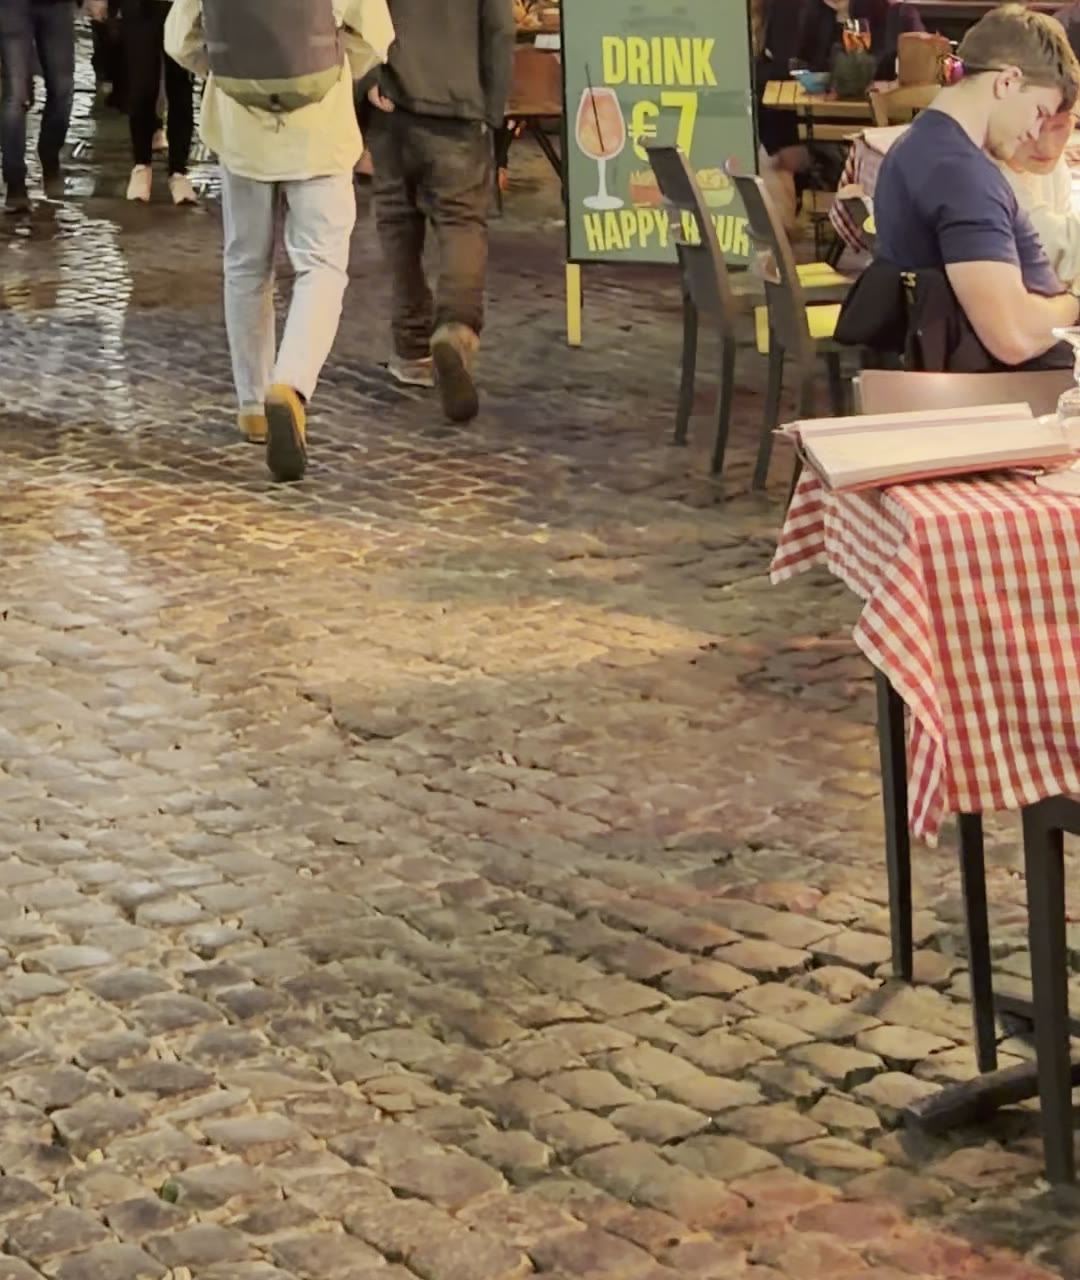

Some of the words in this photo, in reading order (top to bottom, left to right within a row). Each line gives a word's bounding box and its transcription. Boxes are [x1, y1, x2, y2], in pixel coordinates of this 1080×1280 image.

[602, 36, 718, 86] DRINK
[583, 210, 669, 252] HAPPY
[680, 209, 749, 257] HUR
